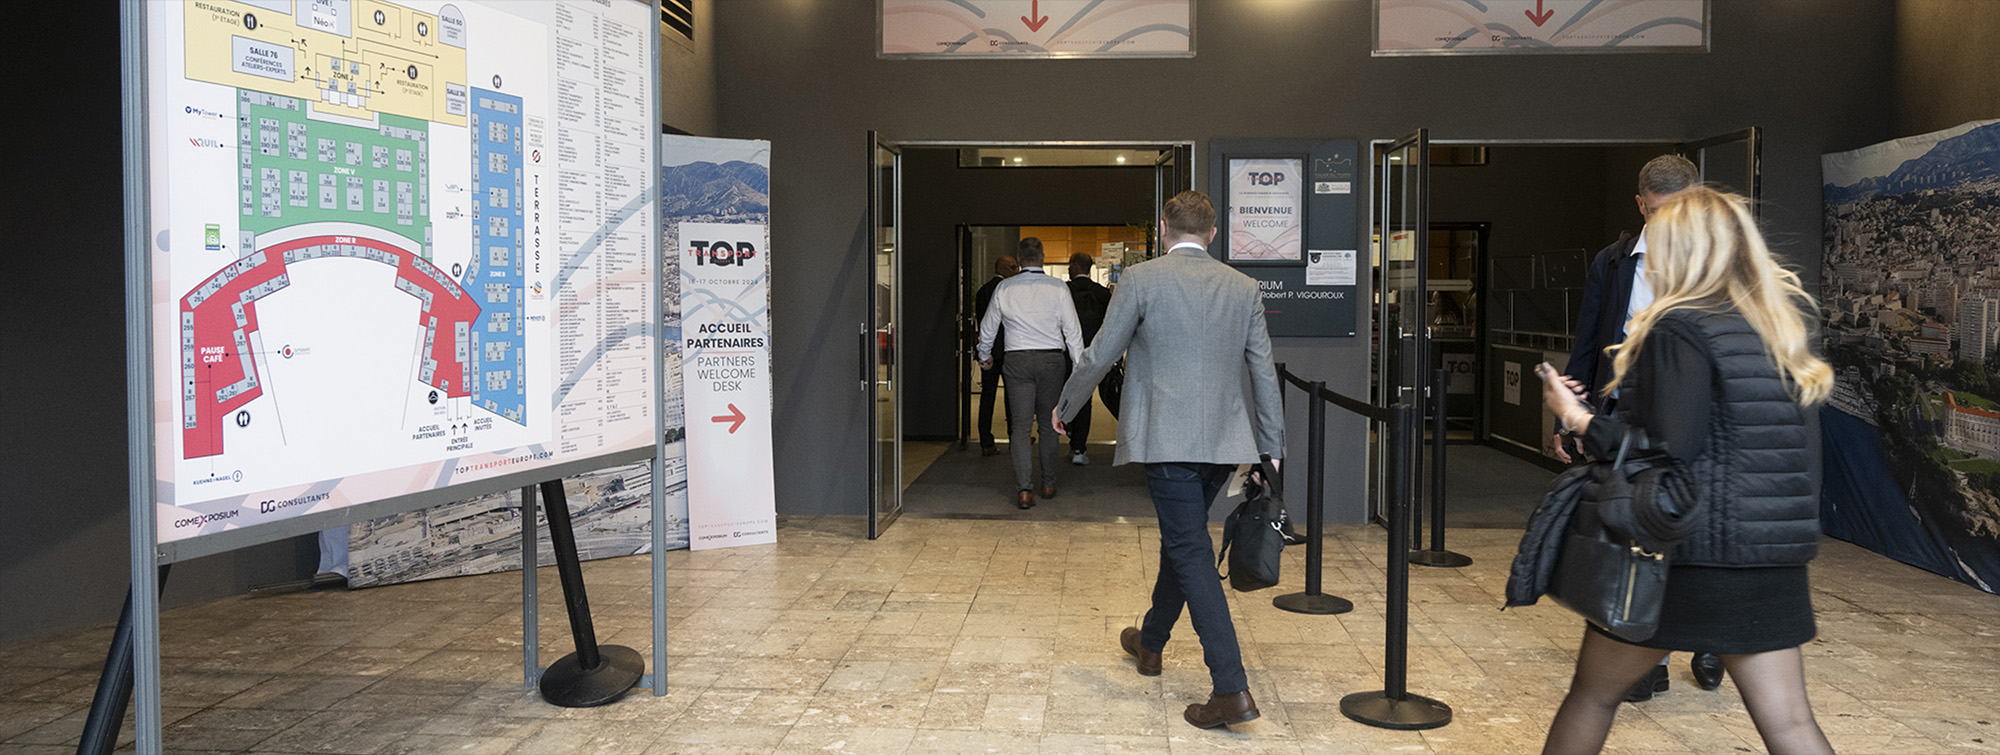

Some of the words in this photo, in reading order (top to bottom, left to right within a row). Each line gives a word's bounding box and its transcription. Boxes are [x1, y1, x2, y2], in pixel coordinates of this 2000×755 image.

[195, 2, 240, 17] RESTAURATION
[442, 15, 455, 24] SALLE
[250, 46, 269, 57] SALLE
[241, 62, 286, 75] ATELIERS-EXPERTS
[333, 71, 348, 80] ZONE
[334, 166, 349, 175] ZONE
[1248, 172, 1285, 186] TOP
[1240, 206, 1292, 214] BIENVENUE
[688, 250, 757, 258] TRANSPORT
[690, 241, 755, 266] TOP
[699, 323, 751, 333] ACCUEIL
[687, 338, 764, 349] PARTENAIRES
[203, 354, 223, 363] CAFÉ
[697, 356, 755, 367] PARTNERS
[697, 368, 756, 380] WELCOME
[1506, 370, 1519, 387] TOP
[713, 381, 742, 392] DESK
[412, 430, 446, 440] PARTENAIRES
[451, 436, 468, 444] ENTRÉE
[446, 442, 473, 452] PRINCIPALE
[455, 450, 554, 474] TOPTRANSPORTEUROPE.COM
[260, 500, 276, 514] DG
[277, 492, 330, 509] CONSULTANTS
[175, 509, 239, 528] COMEXPOSIUM
